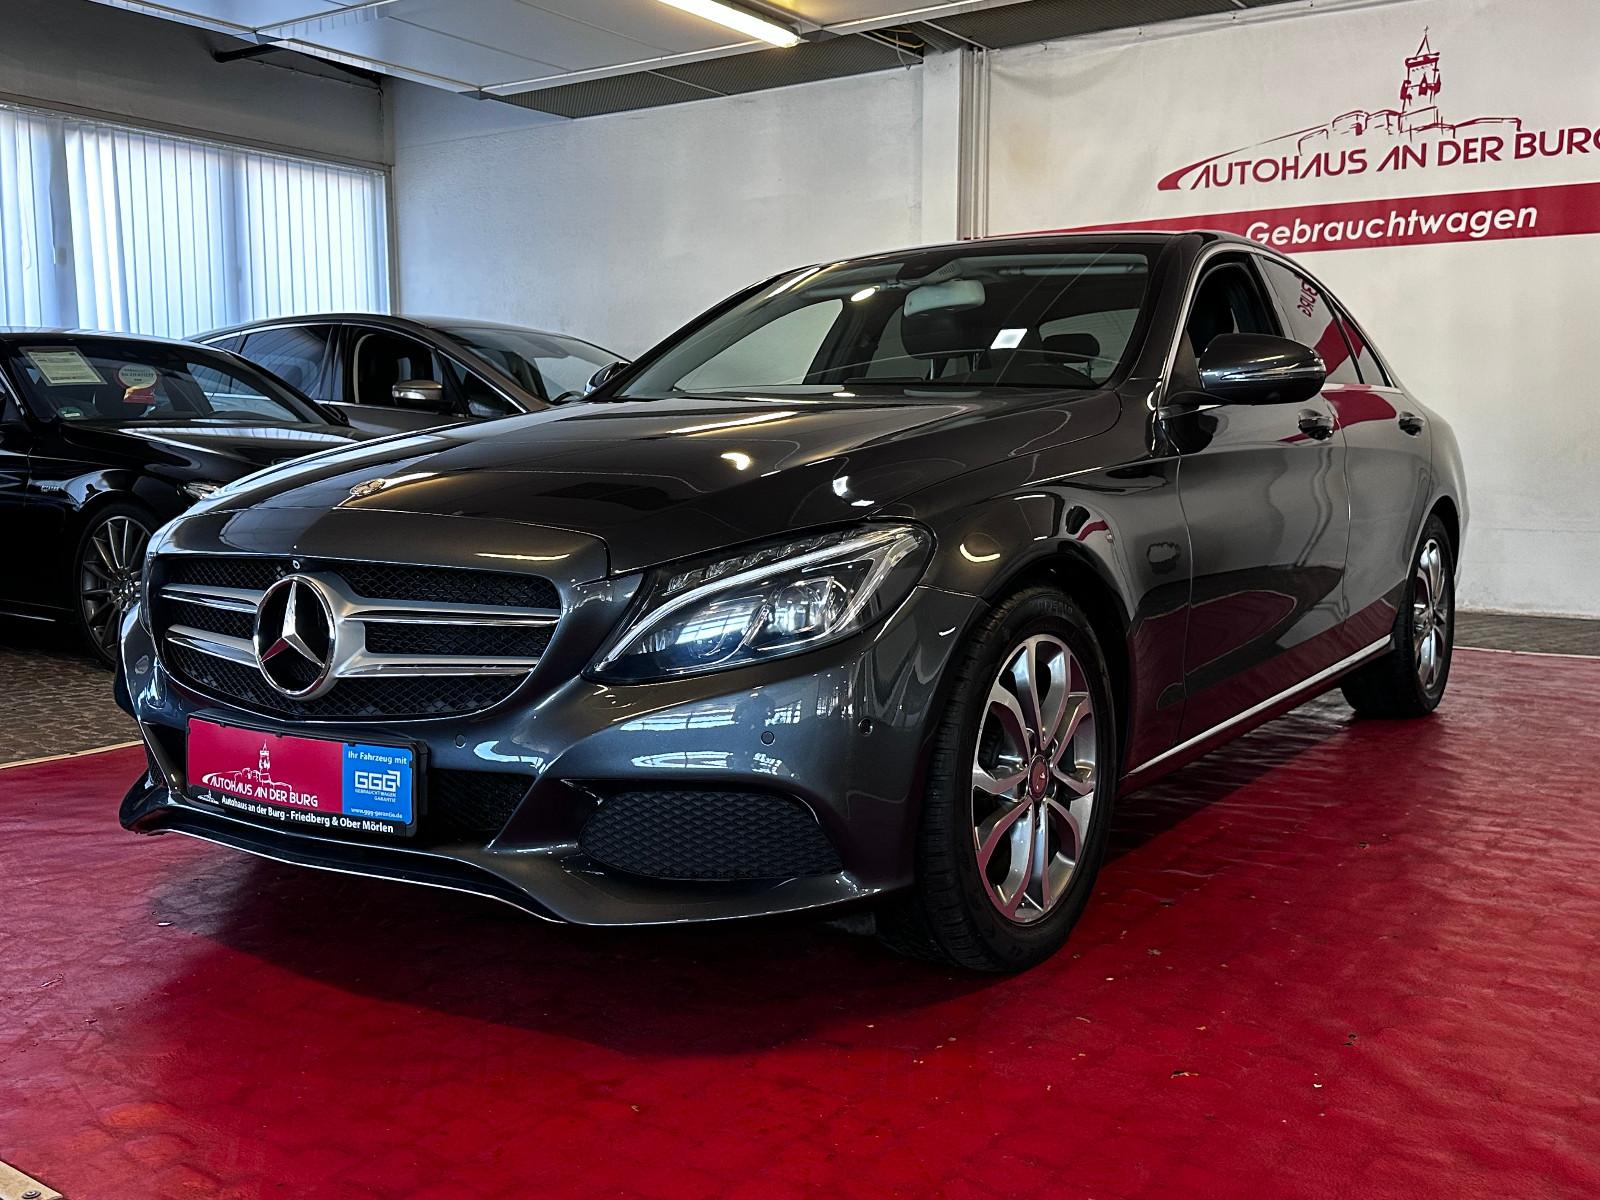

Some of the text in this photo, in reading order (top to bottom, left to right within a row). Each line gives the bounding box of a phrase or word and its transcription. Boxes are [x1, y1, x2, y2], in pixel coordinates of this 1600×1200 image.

[1191, 148, 1368, 190] AUTOHAUS
[1377, 142, 1428, 172] AN
[1437, 135, 1505, 168] DER
[1246, 206, 1538, 247] Gebrauchtwagen
[348, 750, 408, 765] Ihr Fahrzeug mit
[209, 775, 318, 808] AUTOHAUS AN DER BURG
[354, 769, 401, 792] GGG
[221, 795, 248, 812] Autohaus
[248, 804, 256, 813] an
[256, 804, 267, 815] der
[267, 806, 286, 820] Burg
[290, 811, 330, 827] Friedberg
[331, 816, 339, 827] &
[340, 817, 361, 830] Ober
[362, 819, 394, 834] Mörlen
